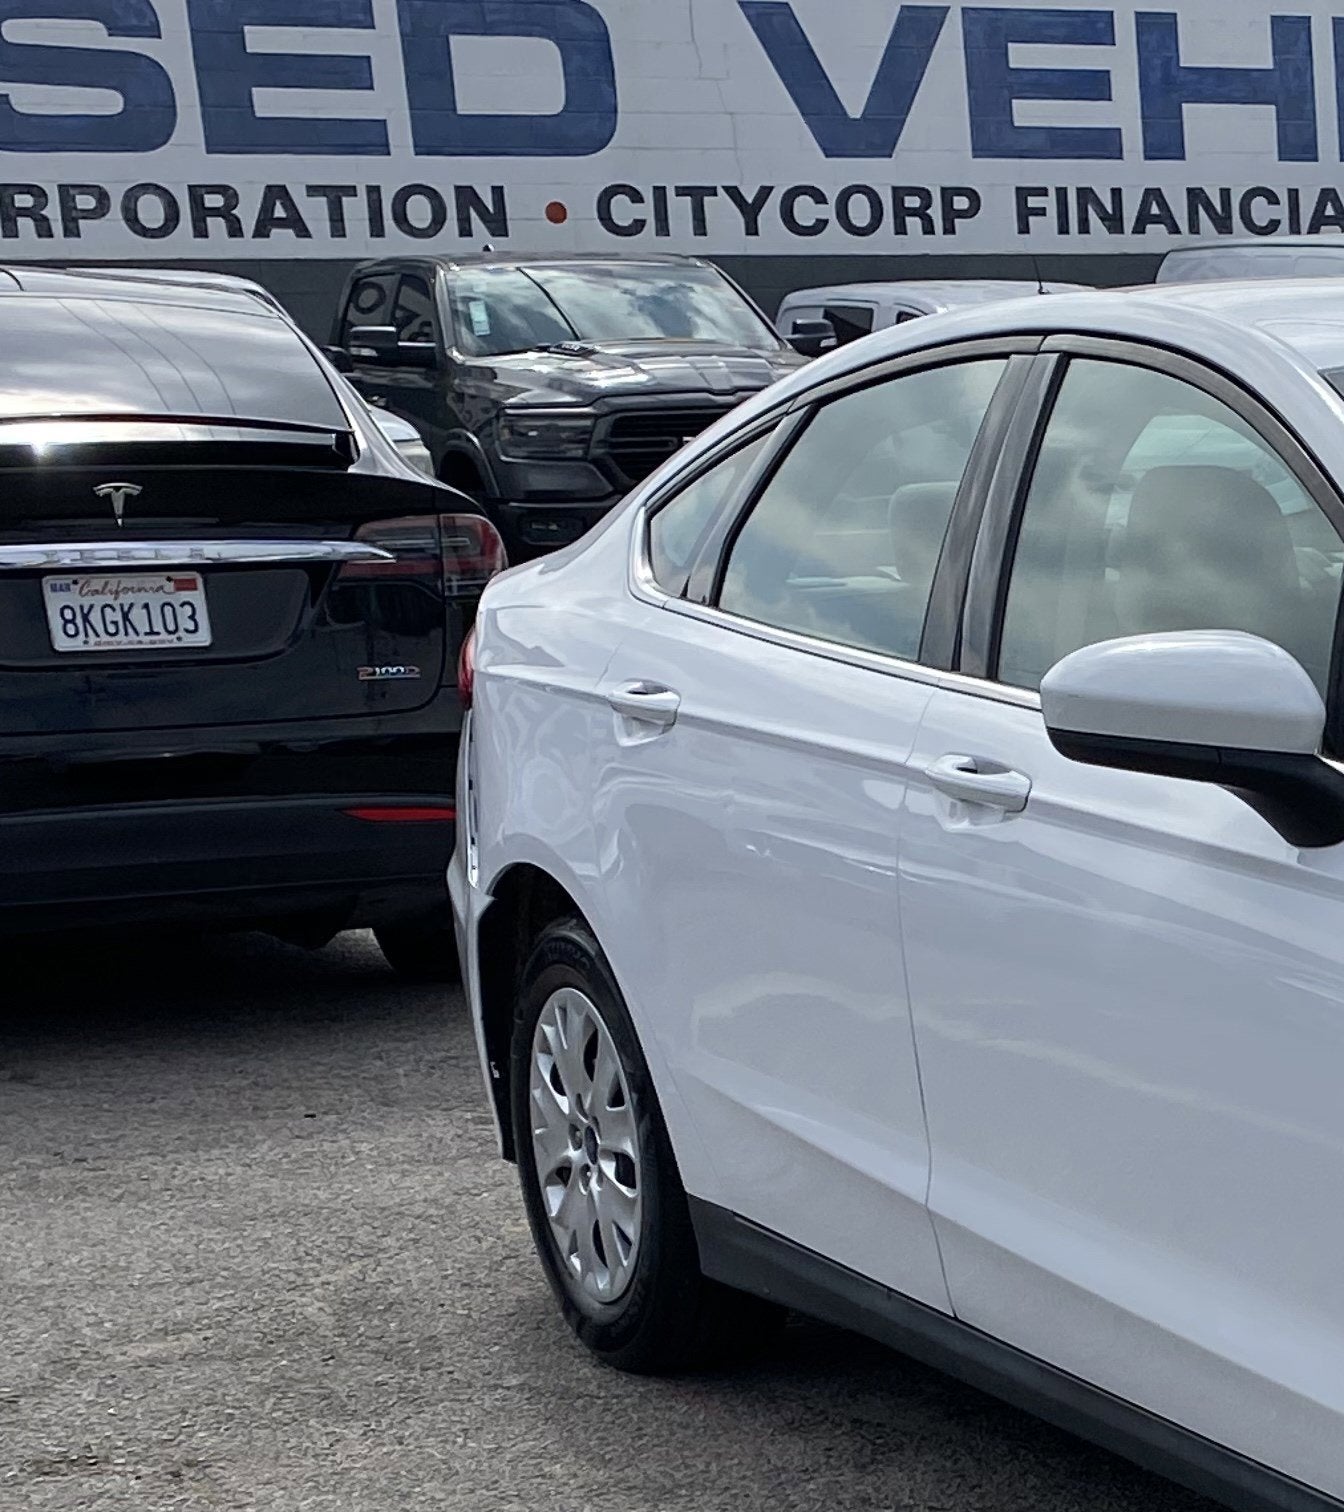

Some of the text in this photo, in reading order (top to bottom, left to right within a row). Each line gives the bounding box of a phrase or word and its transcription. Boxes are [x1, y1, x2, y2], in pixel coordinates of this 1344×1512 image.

[597, 184, 982, 238] CITYCORP
[78, 578, 176, 601] California
[59, 601, 200, 639] 8KGK103
